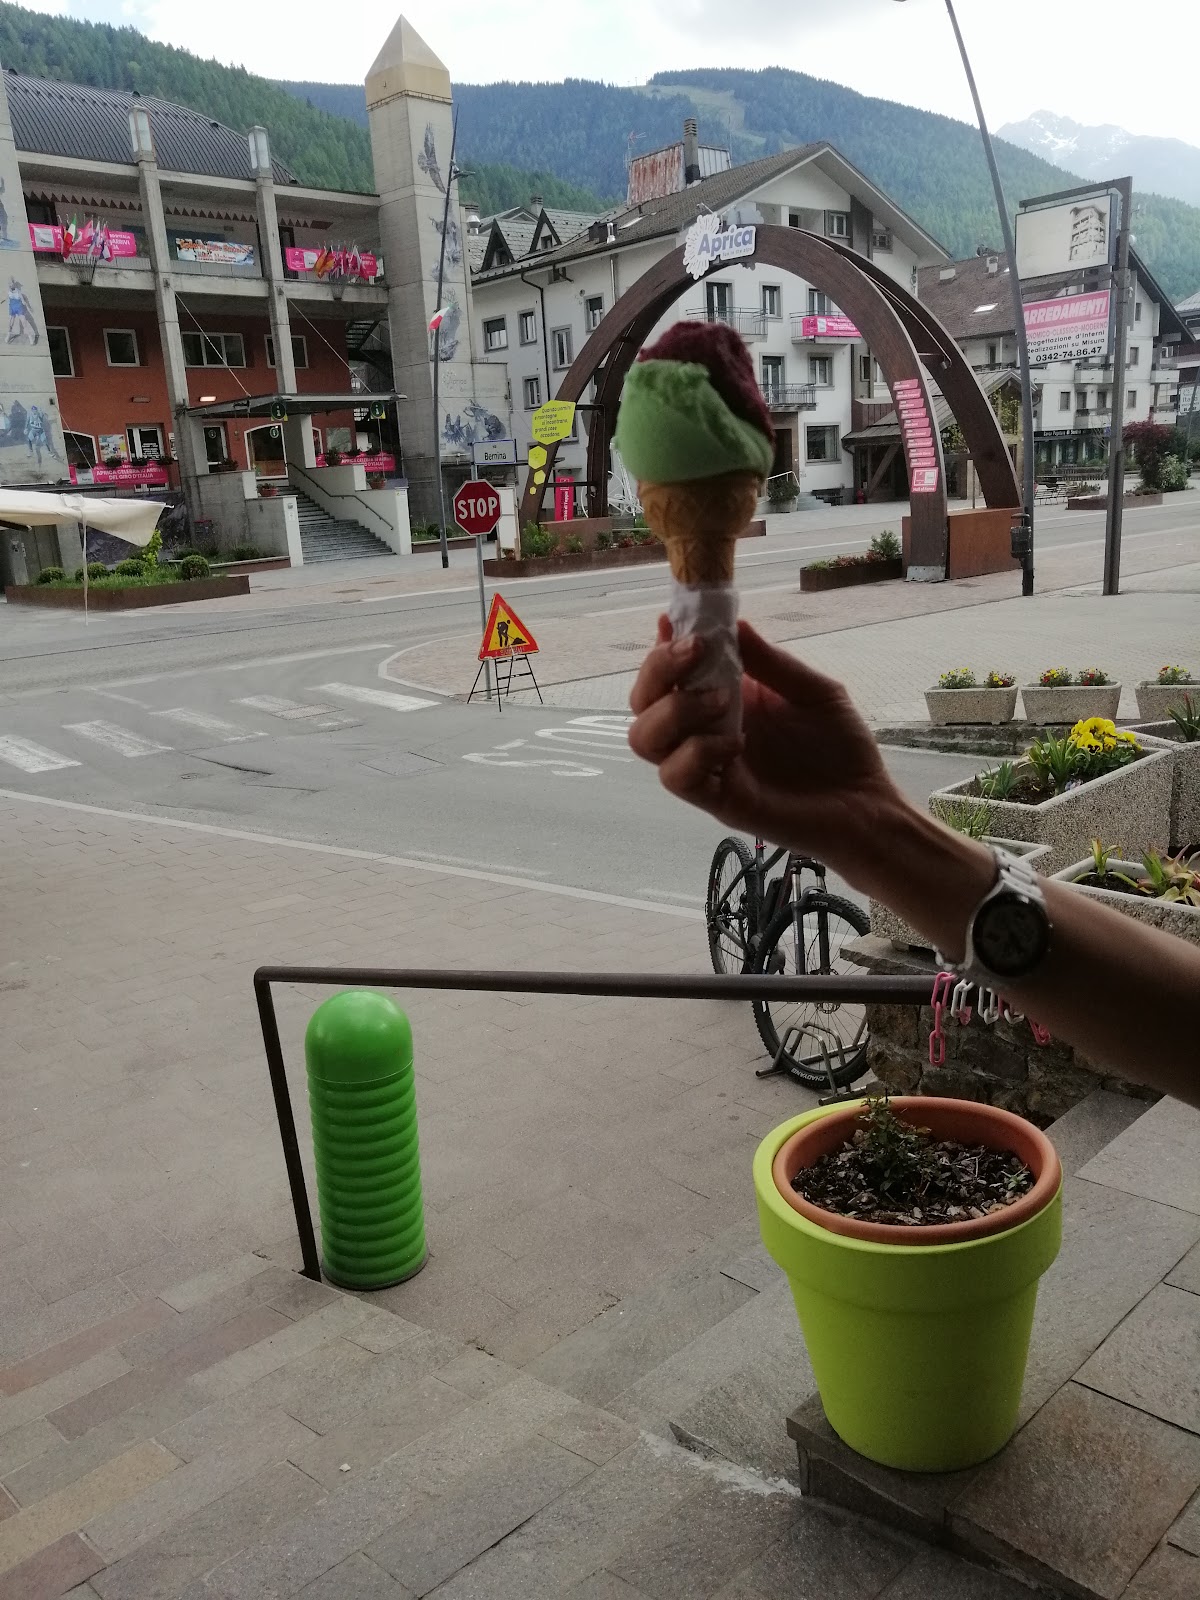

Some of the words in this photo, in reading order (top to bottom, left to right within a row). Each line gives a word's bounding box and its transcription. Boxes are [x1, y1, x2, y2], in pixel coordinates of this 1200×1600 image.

[697, 228, 753, 257] Aprica
[1024, 297, 1108, 326] ARREDAMENTI
[1026, 321, 1108, 340] ONOMICO-CLASSICO-MODERNO
[1075, 330, 1105, 340] d'Interni
[1081, 338, 1105, 346] Misura
[1035, 346, 1102, 362] 0342-74.86.47
[484, 452, 507, 461] Bernina
[457, 496, 498, 520] STOP
